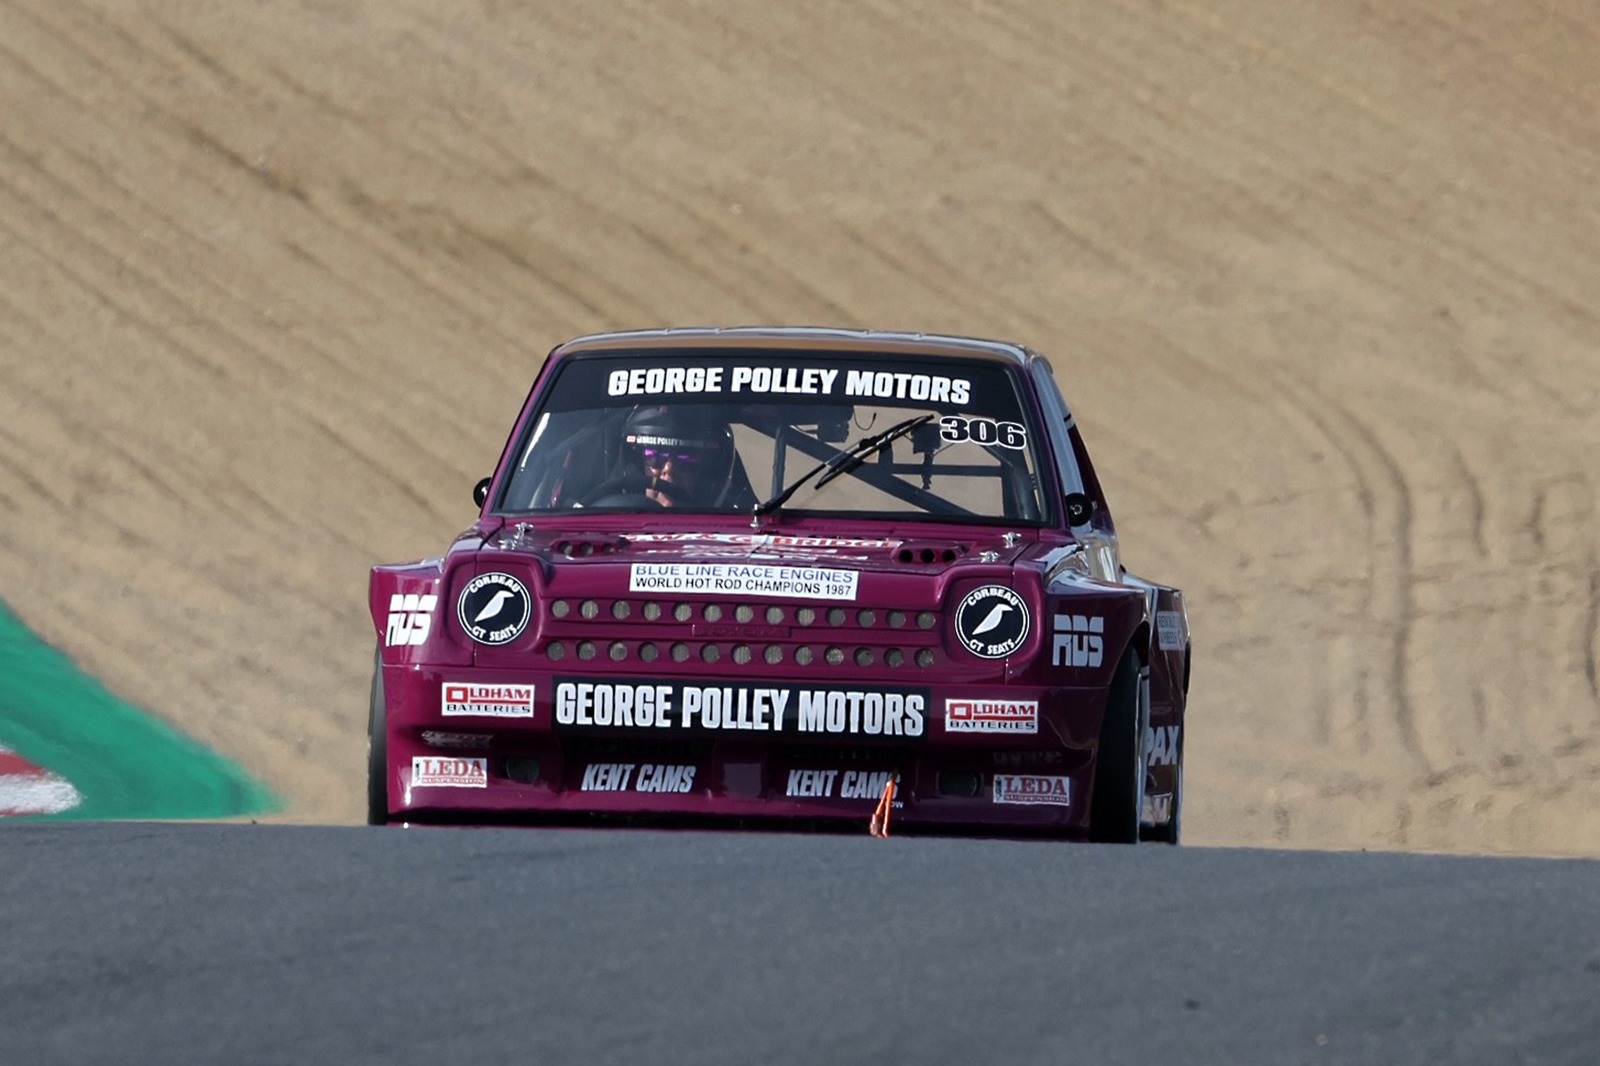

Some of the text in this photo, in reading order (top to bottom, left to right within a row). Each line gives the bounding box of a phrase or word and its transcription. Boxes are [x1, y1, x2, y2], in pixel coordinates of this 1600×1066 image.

[608, 367, 971, 405] GEORGE POLLEY MOTORS
[939, 416, 1027, 449] 306
[636, 565, 853, 583] BLUE LINE RACE ENGINES
[469, 575, 521, 594] CORBEAU
[635, 577, 851, 595] WORLD HOT ROD CHAMPIONS 1987
[967, 587, 1019, 606] CORBEAU
[472, 624, 517, 641] GT SEATS
[969, 638, 1015, 655] GT SEATS
[446, 686, 531, 703] OLDHAM
[446, 704, 530, 714] BATTERIES
[556, 683, 924, 737] GEORGE POLLEY MOTORS
[950, 703, 1035, 720] OLDHAM
[950, 720, 1035, 730] BATTERIES
[423, 759, 484, 777] LEDA
[581, 764, 696, 793] KENT CAMS
[786, 769, 838, 797] KENT
[1004, 777, 1067, 795] LEDA
